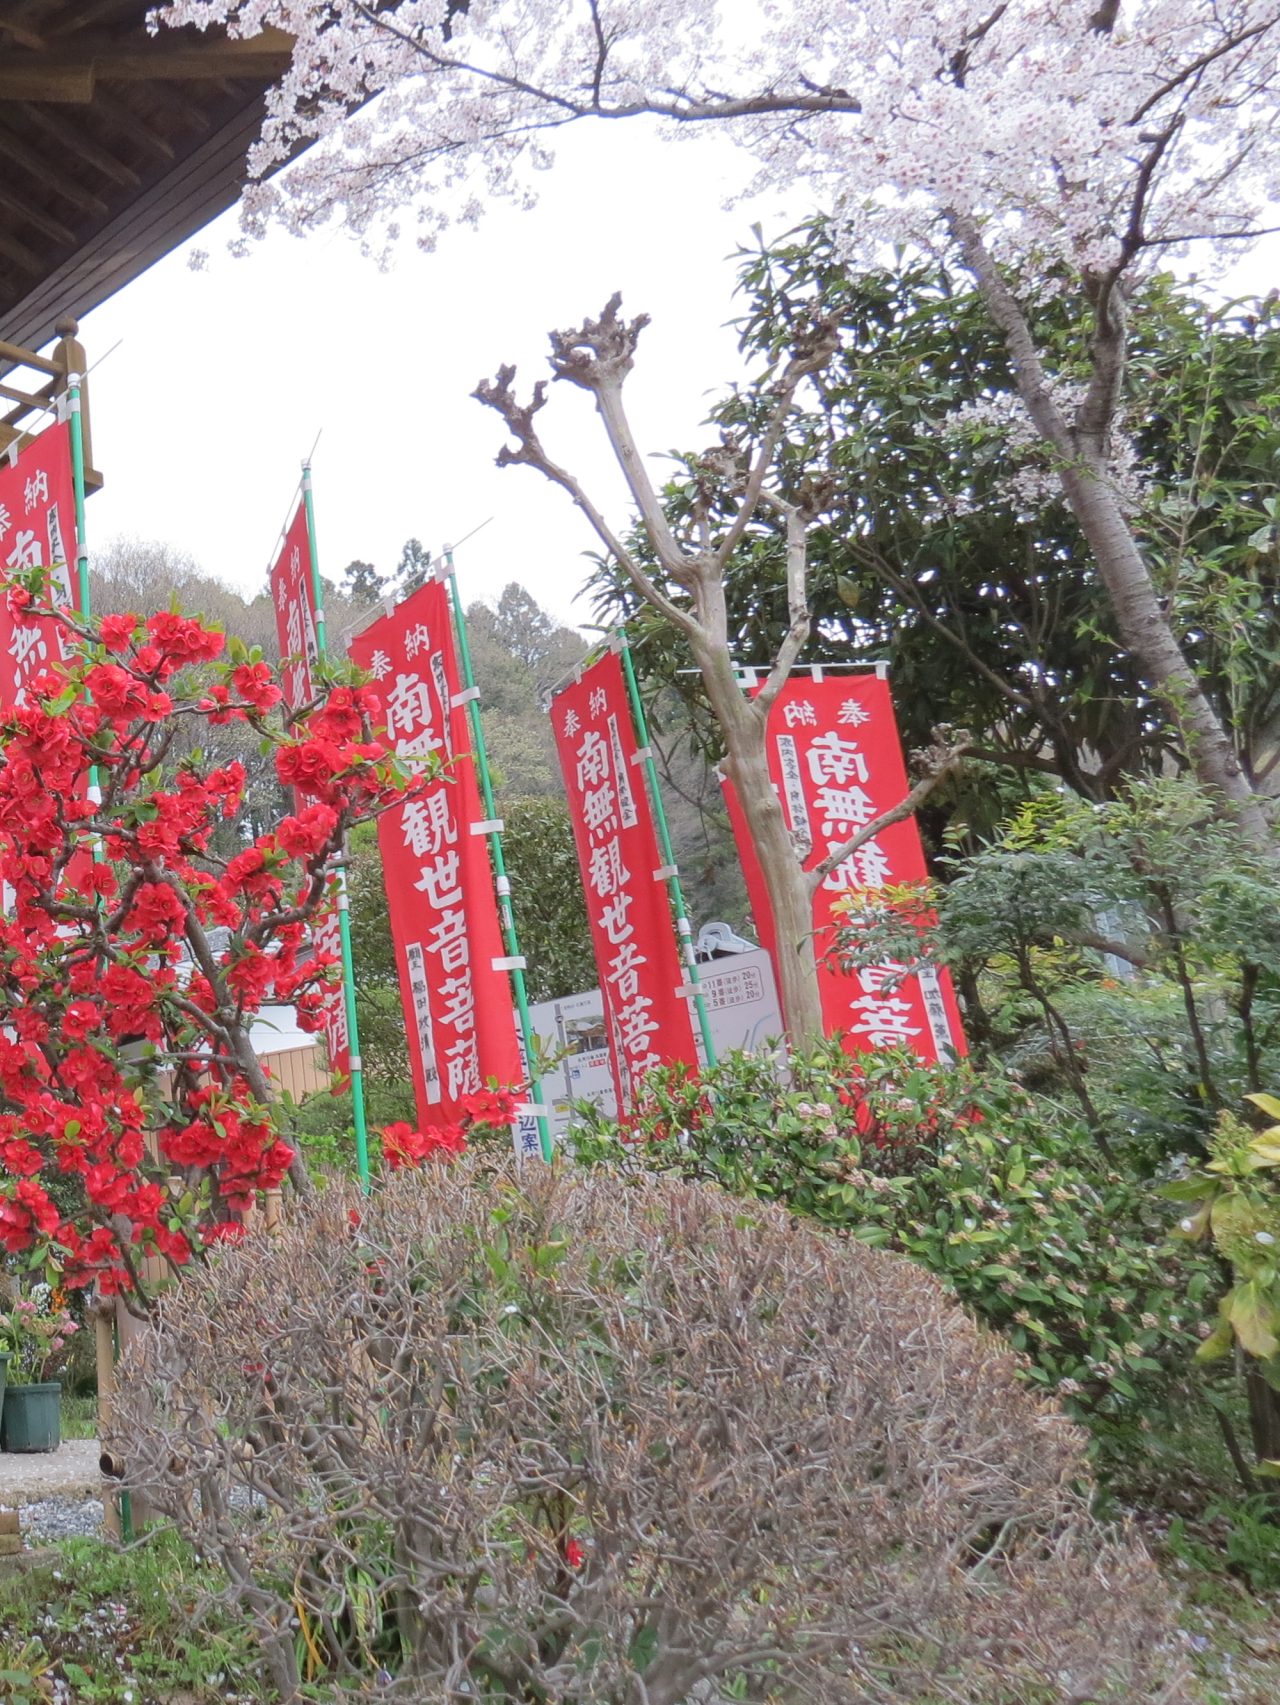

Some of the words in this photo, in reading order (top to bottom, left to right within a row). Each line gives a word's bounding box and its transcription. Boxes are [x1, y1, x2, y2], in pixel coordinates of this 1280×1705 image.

[277, 545, 301, 611] 奉納
[370, 623, 430, 682] 奉納
[563, 687, 608, 738] 奉納
[386, 673, 485, 1102] 南無観世音菩薩
